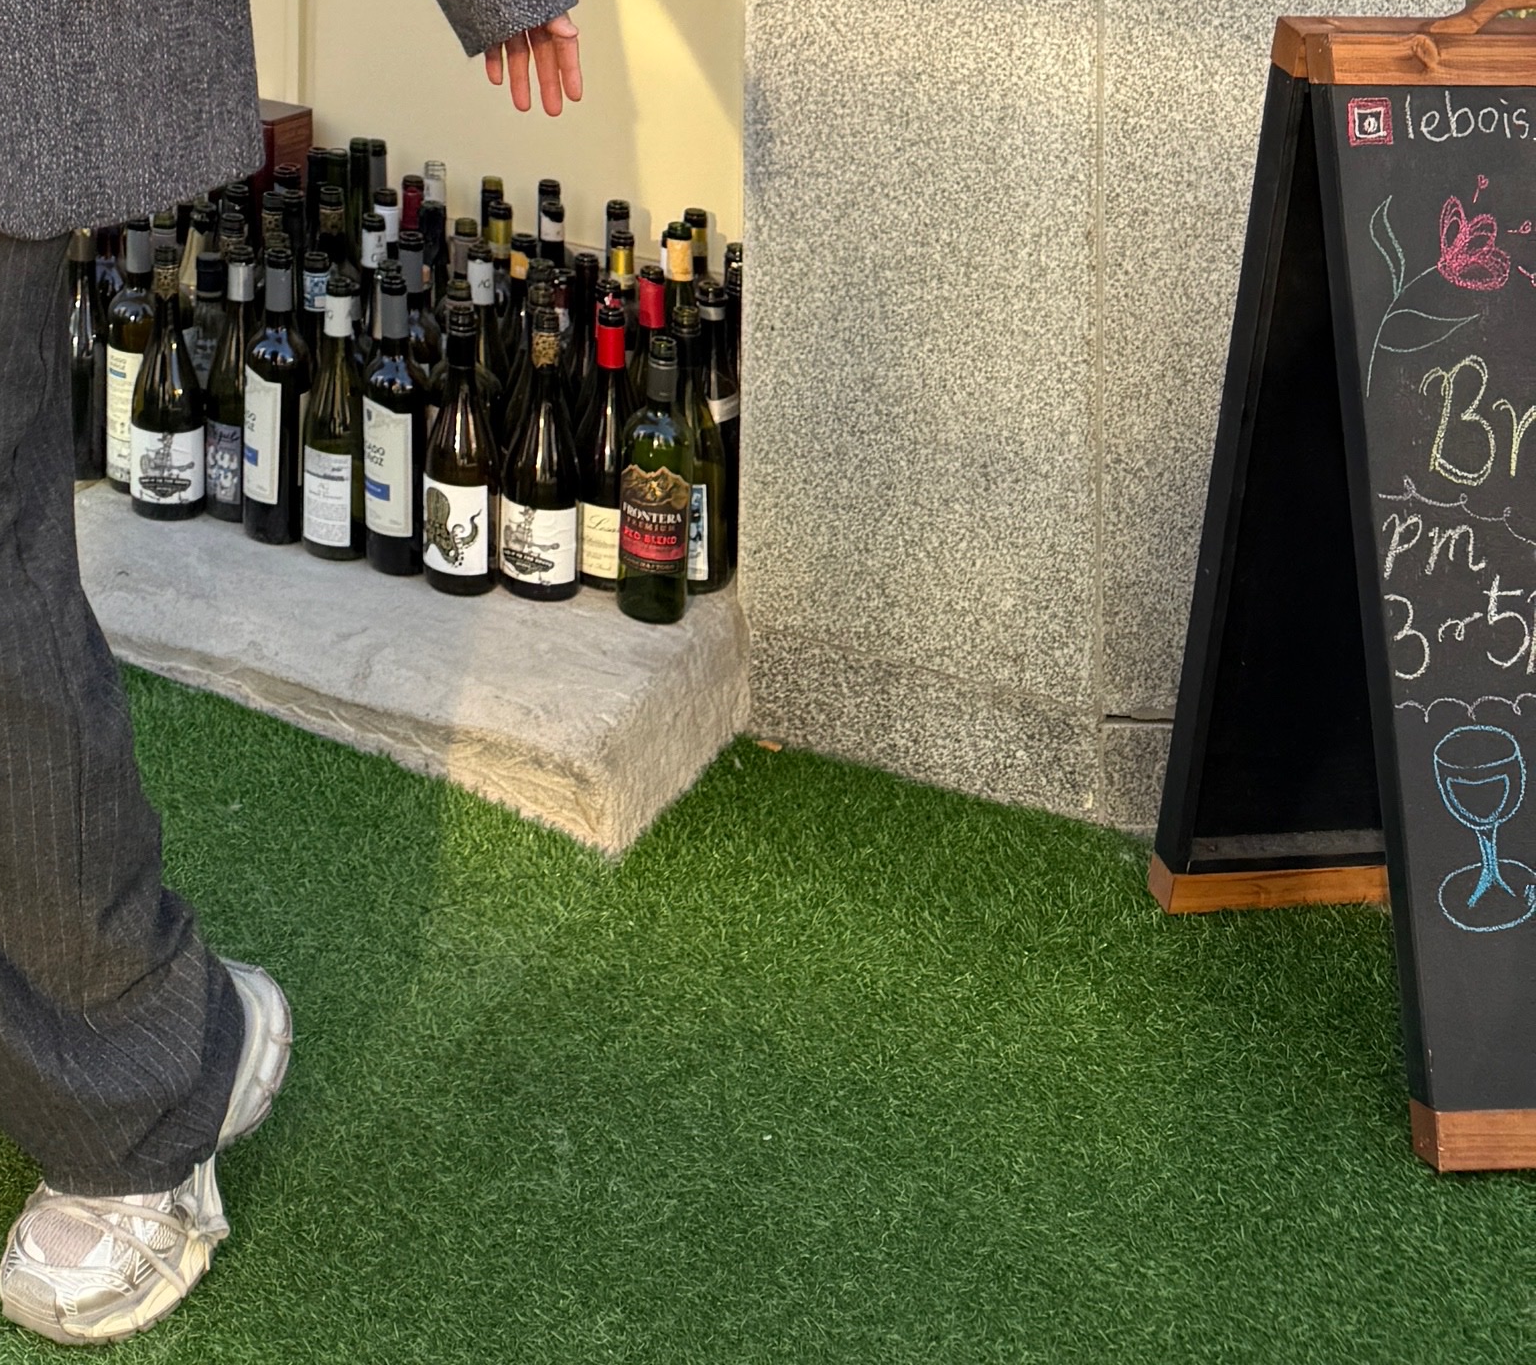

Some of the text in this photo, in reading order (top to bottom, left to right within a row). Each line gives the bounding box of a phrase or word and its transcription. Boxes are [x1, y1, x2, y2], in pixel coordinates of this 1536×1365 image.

[1404, 89, 1536, 143] lebois
[623, 501, 683, 525] FRONTERA
[1382, 513, 1487, 581] pm
